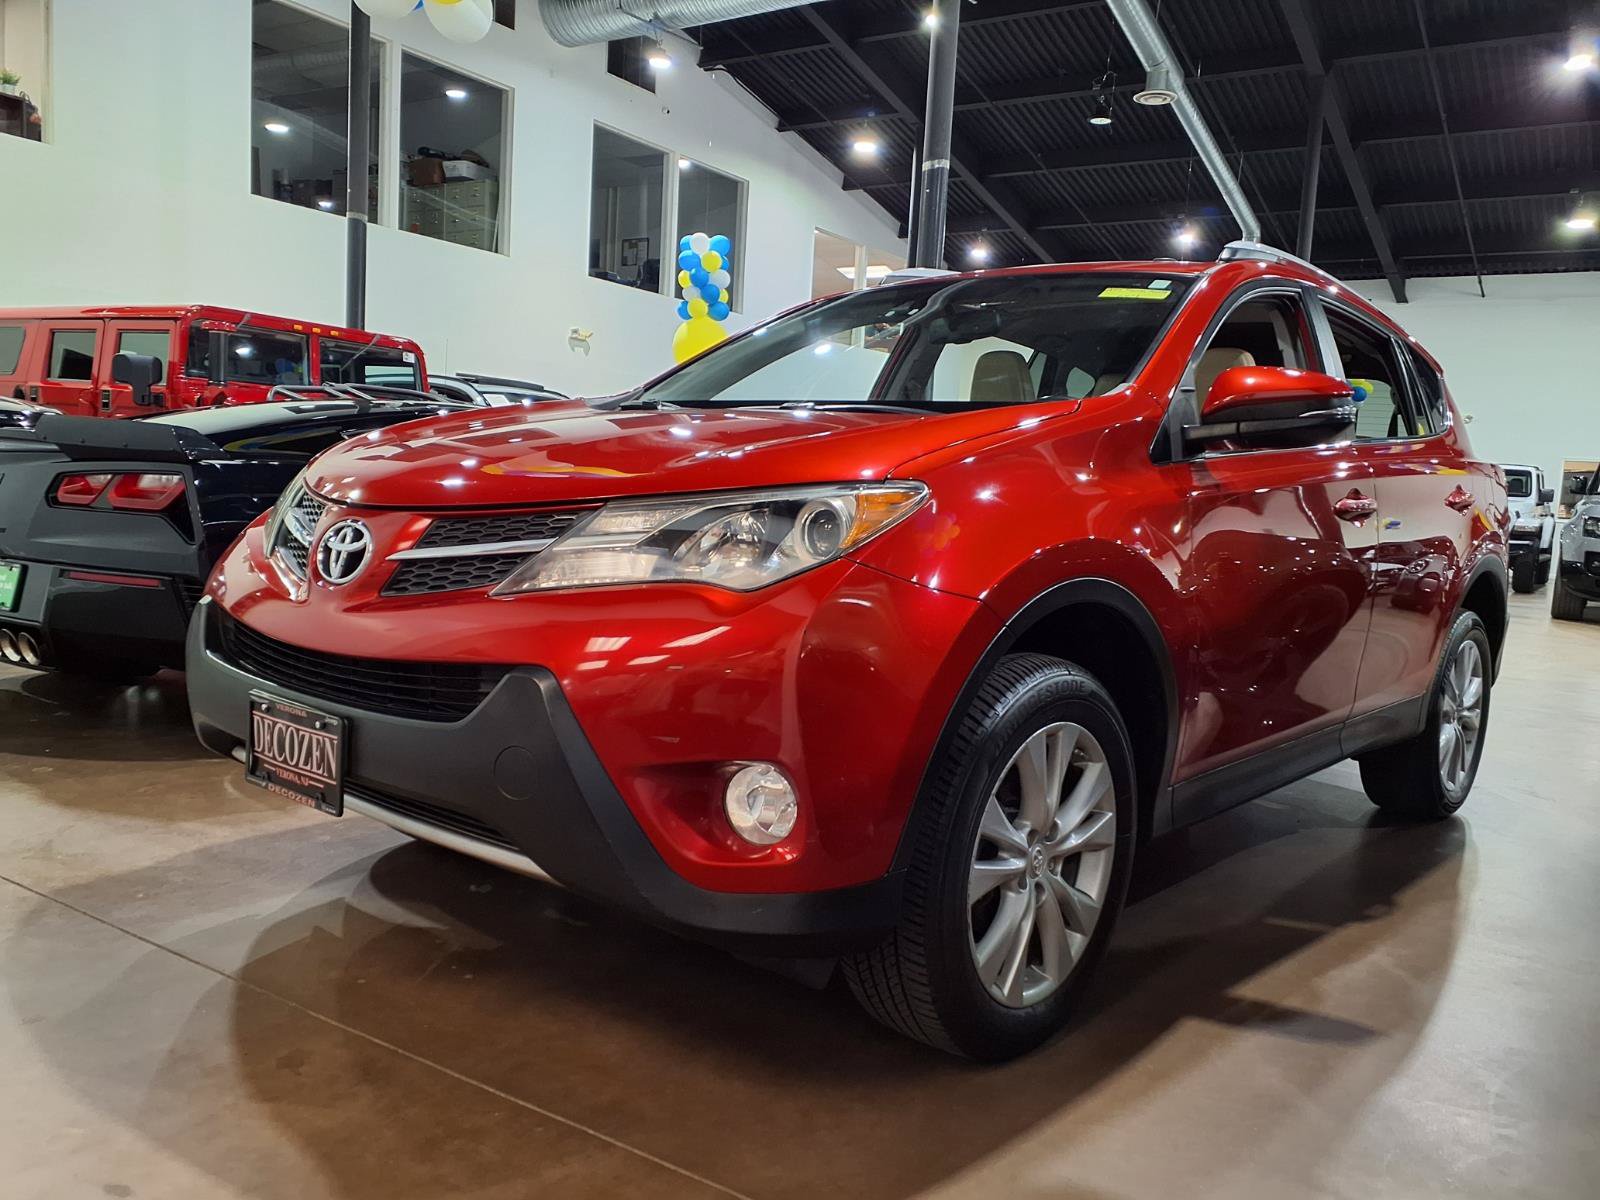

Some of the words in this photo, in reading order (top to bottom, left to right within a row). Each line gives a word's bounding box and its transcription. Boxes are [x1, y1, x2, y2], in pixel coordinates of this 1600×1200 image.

[276, 704, 307, 717] VERONA
[253, 715, 337, 778] DECOZEN
[268, 784, 315, 807] DECOZEN
